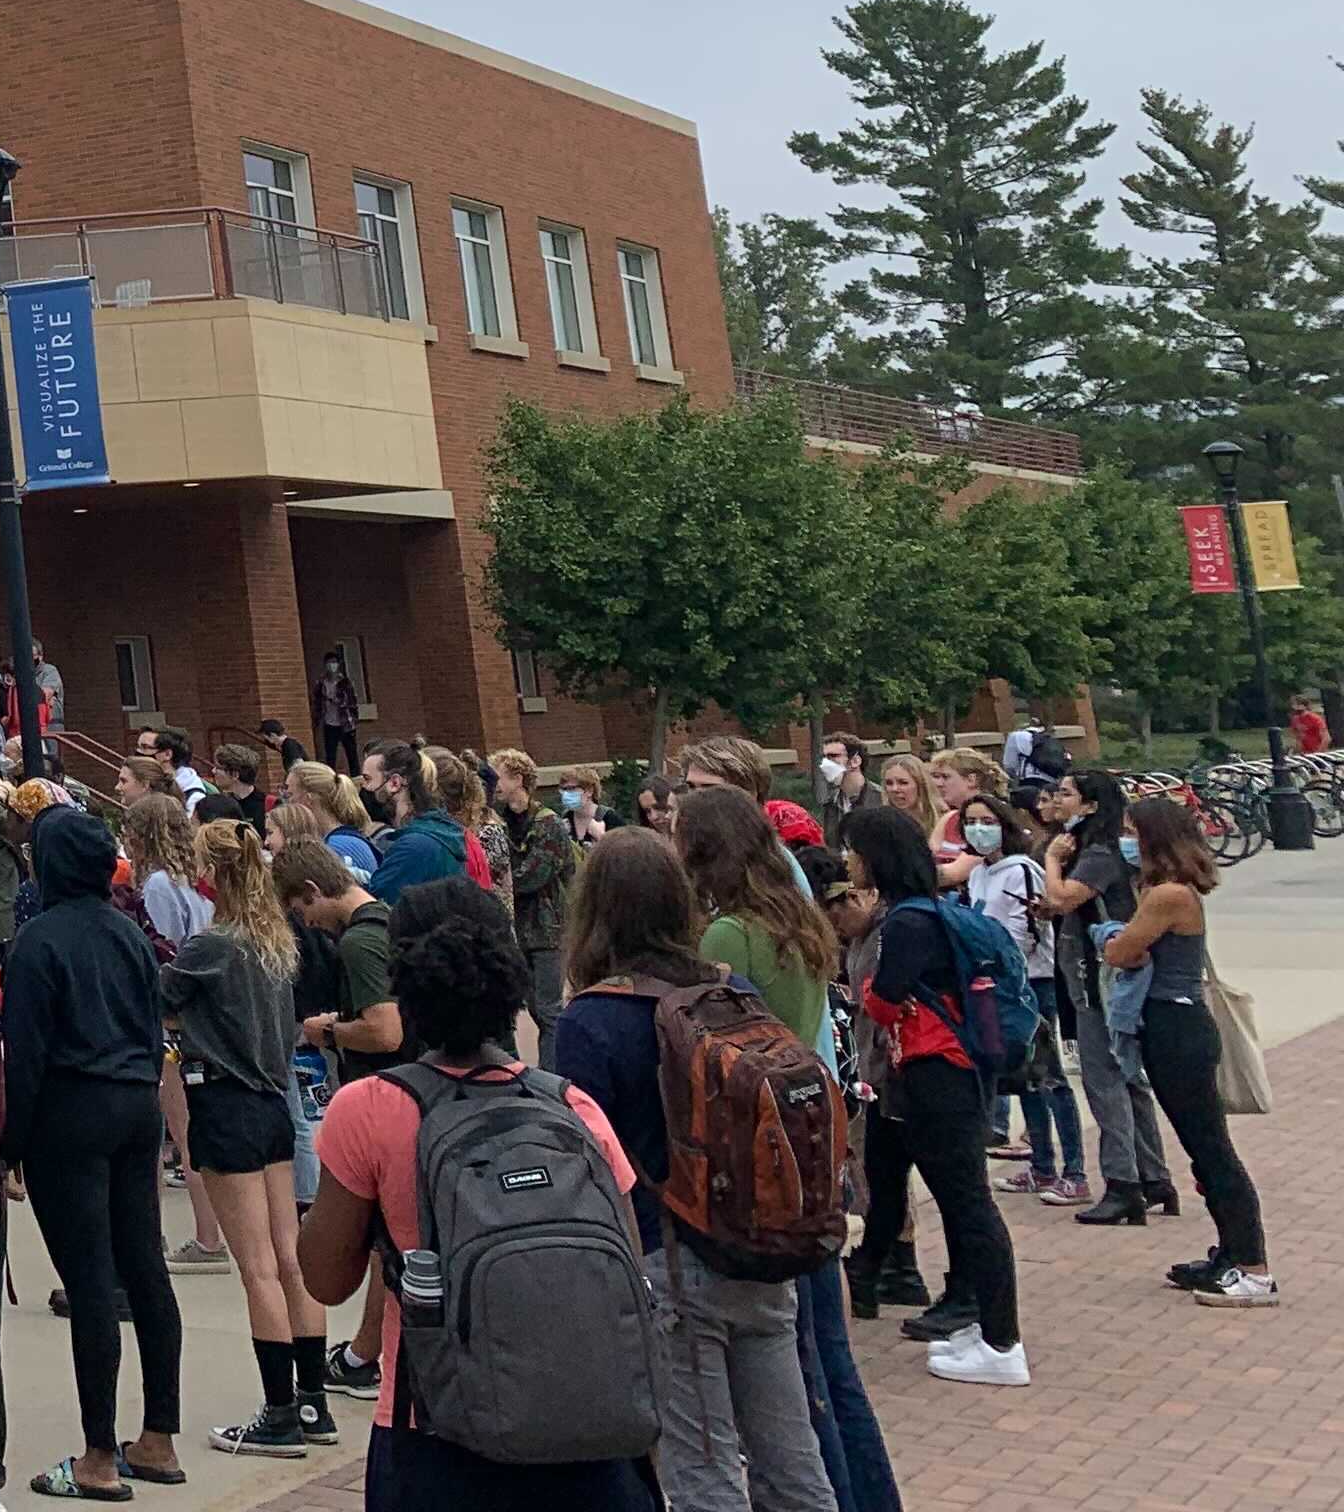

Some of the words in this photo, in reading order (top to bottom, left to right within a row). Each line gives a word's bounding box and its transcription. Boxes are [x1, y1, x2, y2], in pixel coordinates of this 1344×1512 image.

[32, 303, 44, 334] THE
[35, 343, 54, 432] VISUALIZE
[49, 312, 82, 438] FUTURE
[1193, 527, 1217, 573] SEEK
